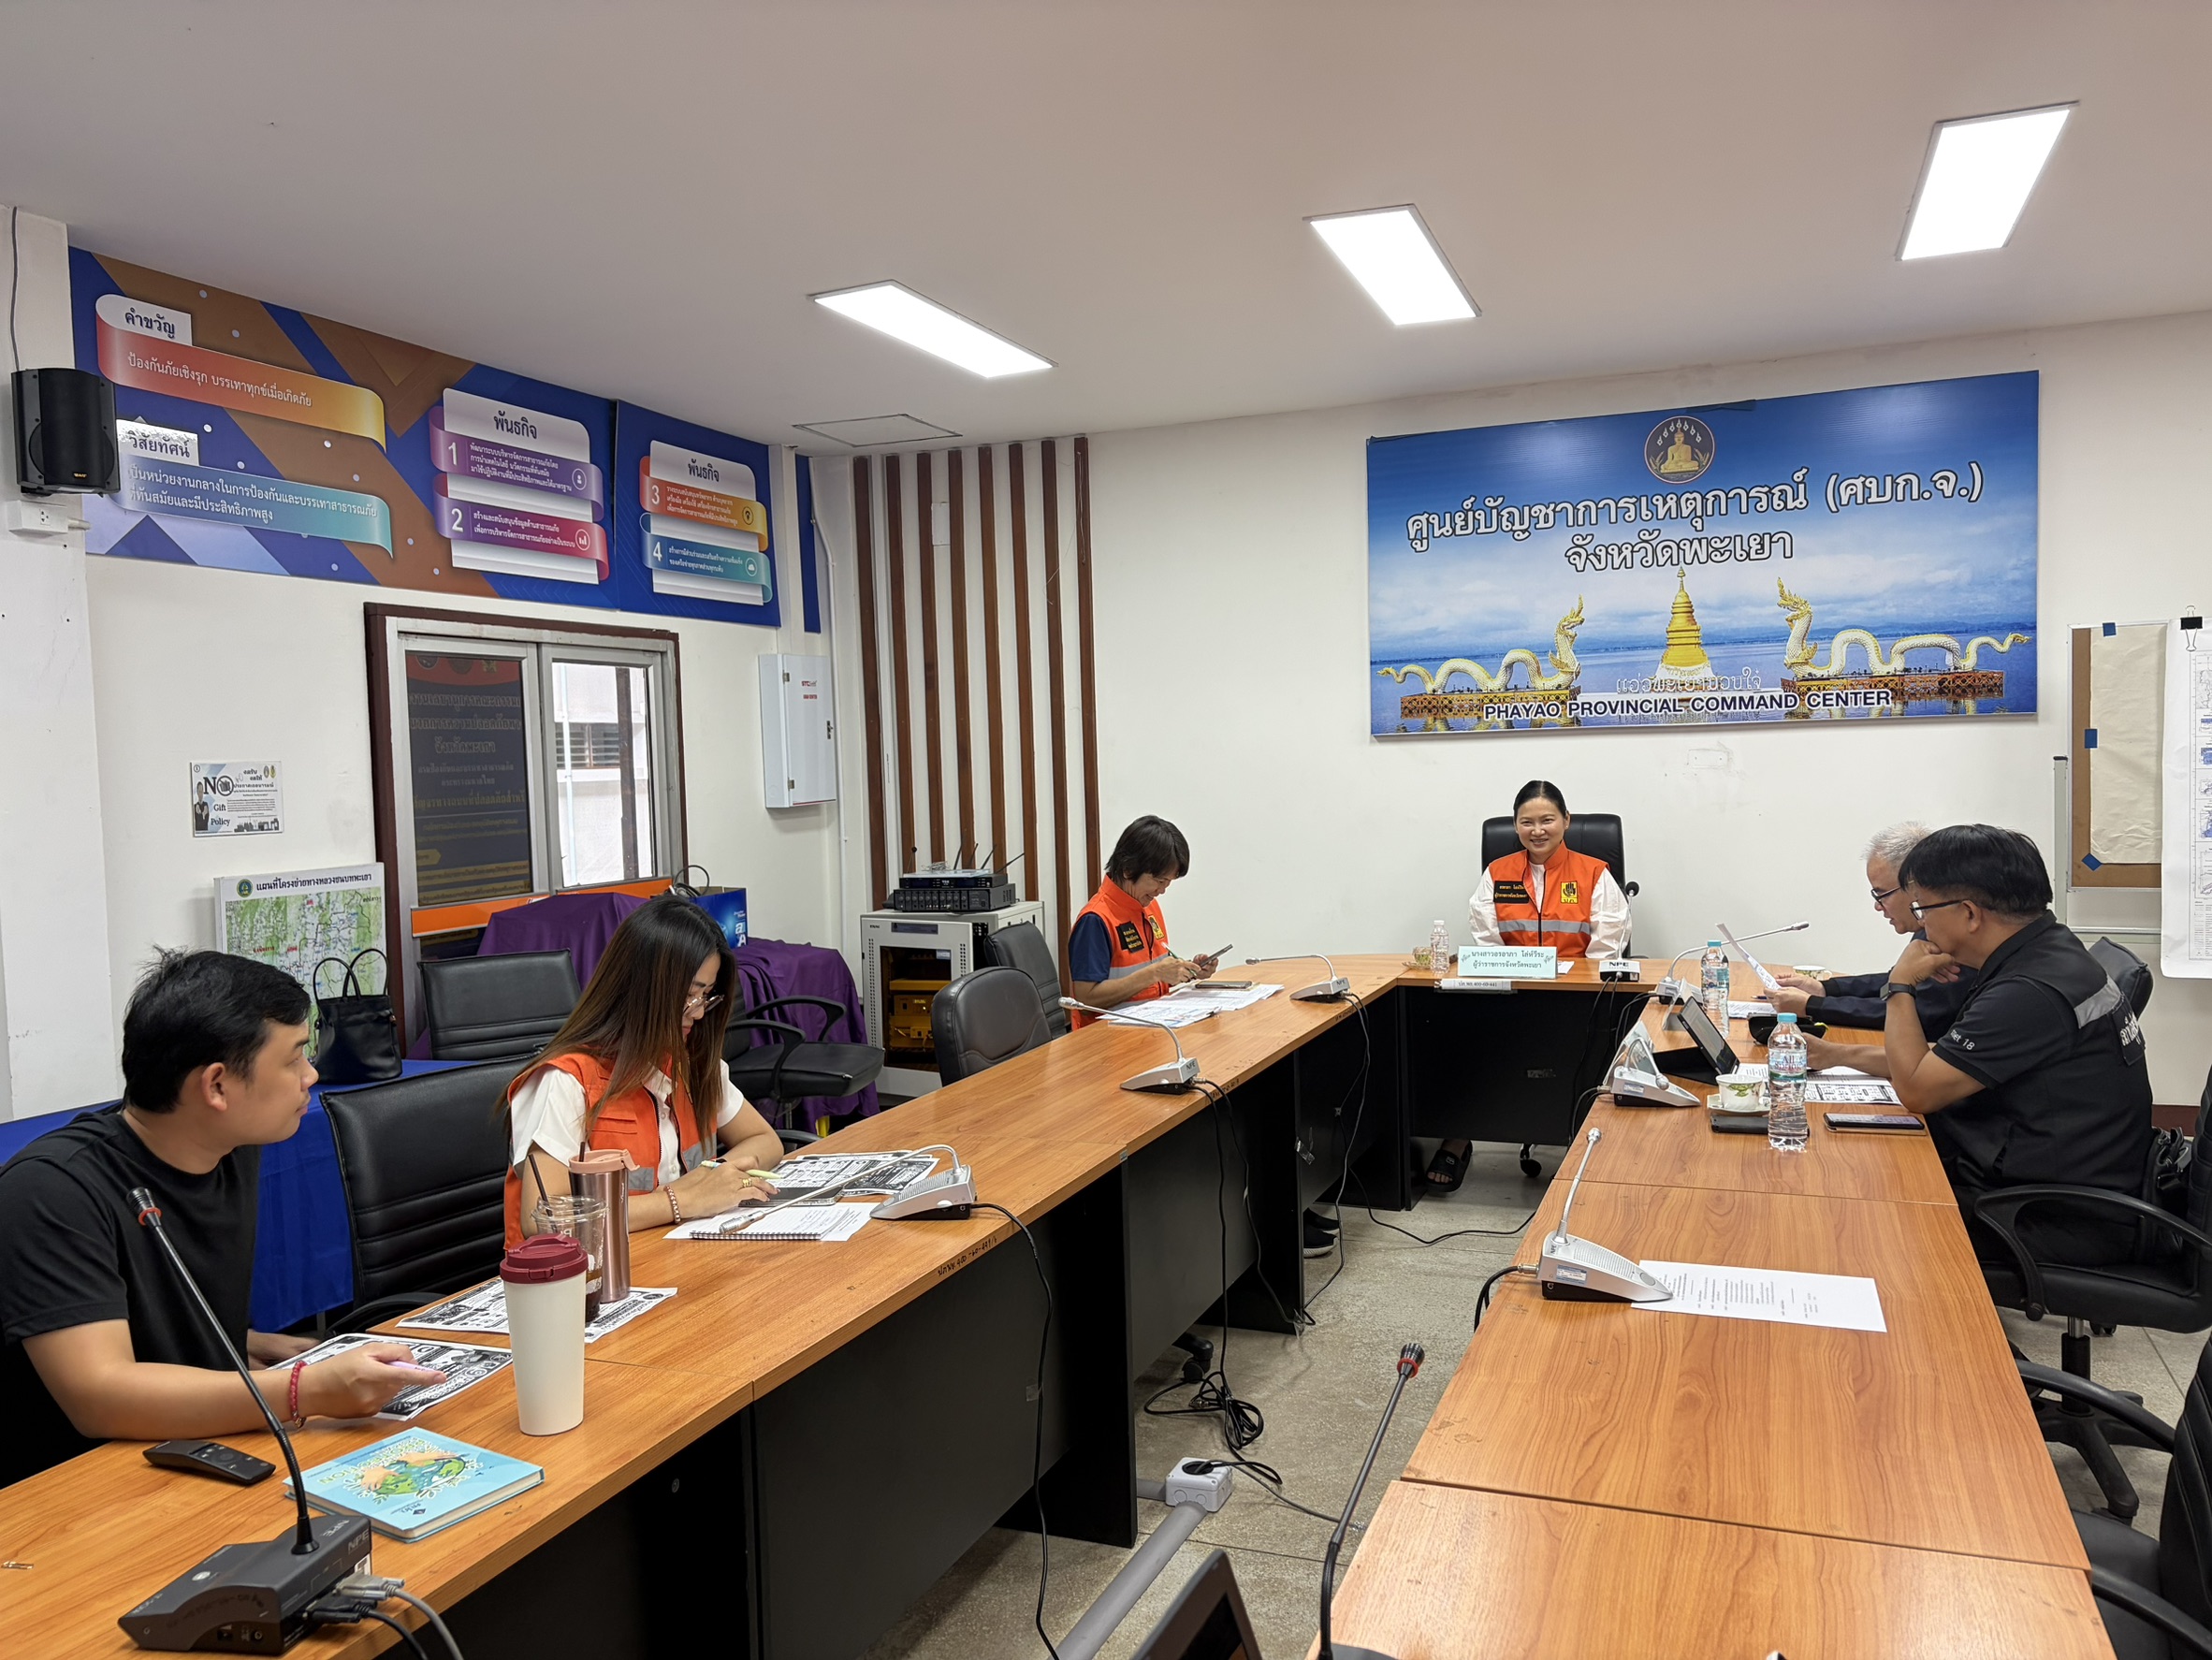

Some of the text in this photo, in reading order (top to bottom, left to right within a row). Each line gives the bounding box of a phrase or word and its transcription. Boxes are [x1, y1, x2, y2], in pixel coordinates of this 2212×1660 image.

[124, 307, 176, 339] คำขวัญ
[127, 351, 313, 407] ป้องกันภัยเชิงรุก บรรเทาทุกข์เมื่อเกิดภัย
[493, 410, 538, 439] พันธกิจ
[129, 430, 191, 459] วิสัยทัศน์
[448, 442, 458, 466] 1
[688, 458, 720, 482] พันธกิจ
[651, 485, 661, 505] 3
[1406, 461, 1985, 552] ศูนย์บัญชาการเหตุการณ์ (ศบก.จ.)
[451, 507, 464, 532] 2
[652, 541, 662, 561] 4
[1564, 529, 1794, 575] จังหวัดพะเยา
[1483, 690, 1891, 720] PHAYAO PROVINCIAL COMMAND CENTER
[213, 803, 226, 812] Gift
[211, 817, 231, 826] Policy
[1472, 960, 1542, 969] ผู้ว่าราชการจังหวัดพะเยา
[1962, 1038, 1975, 1051] 18
[1783, 1055, 1795, 1064] All
[347, 1528, 370, 1555] NPE
